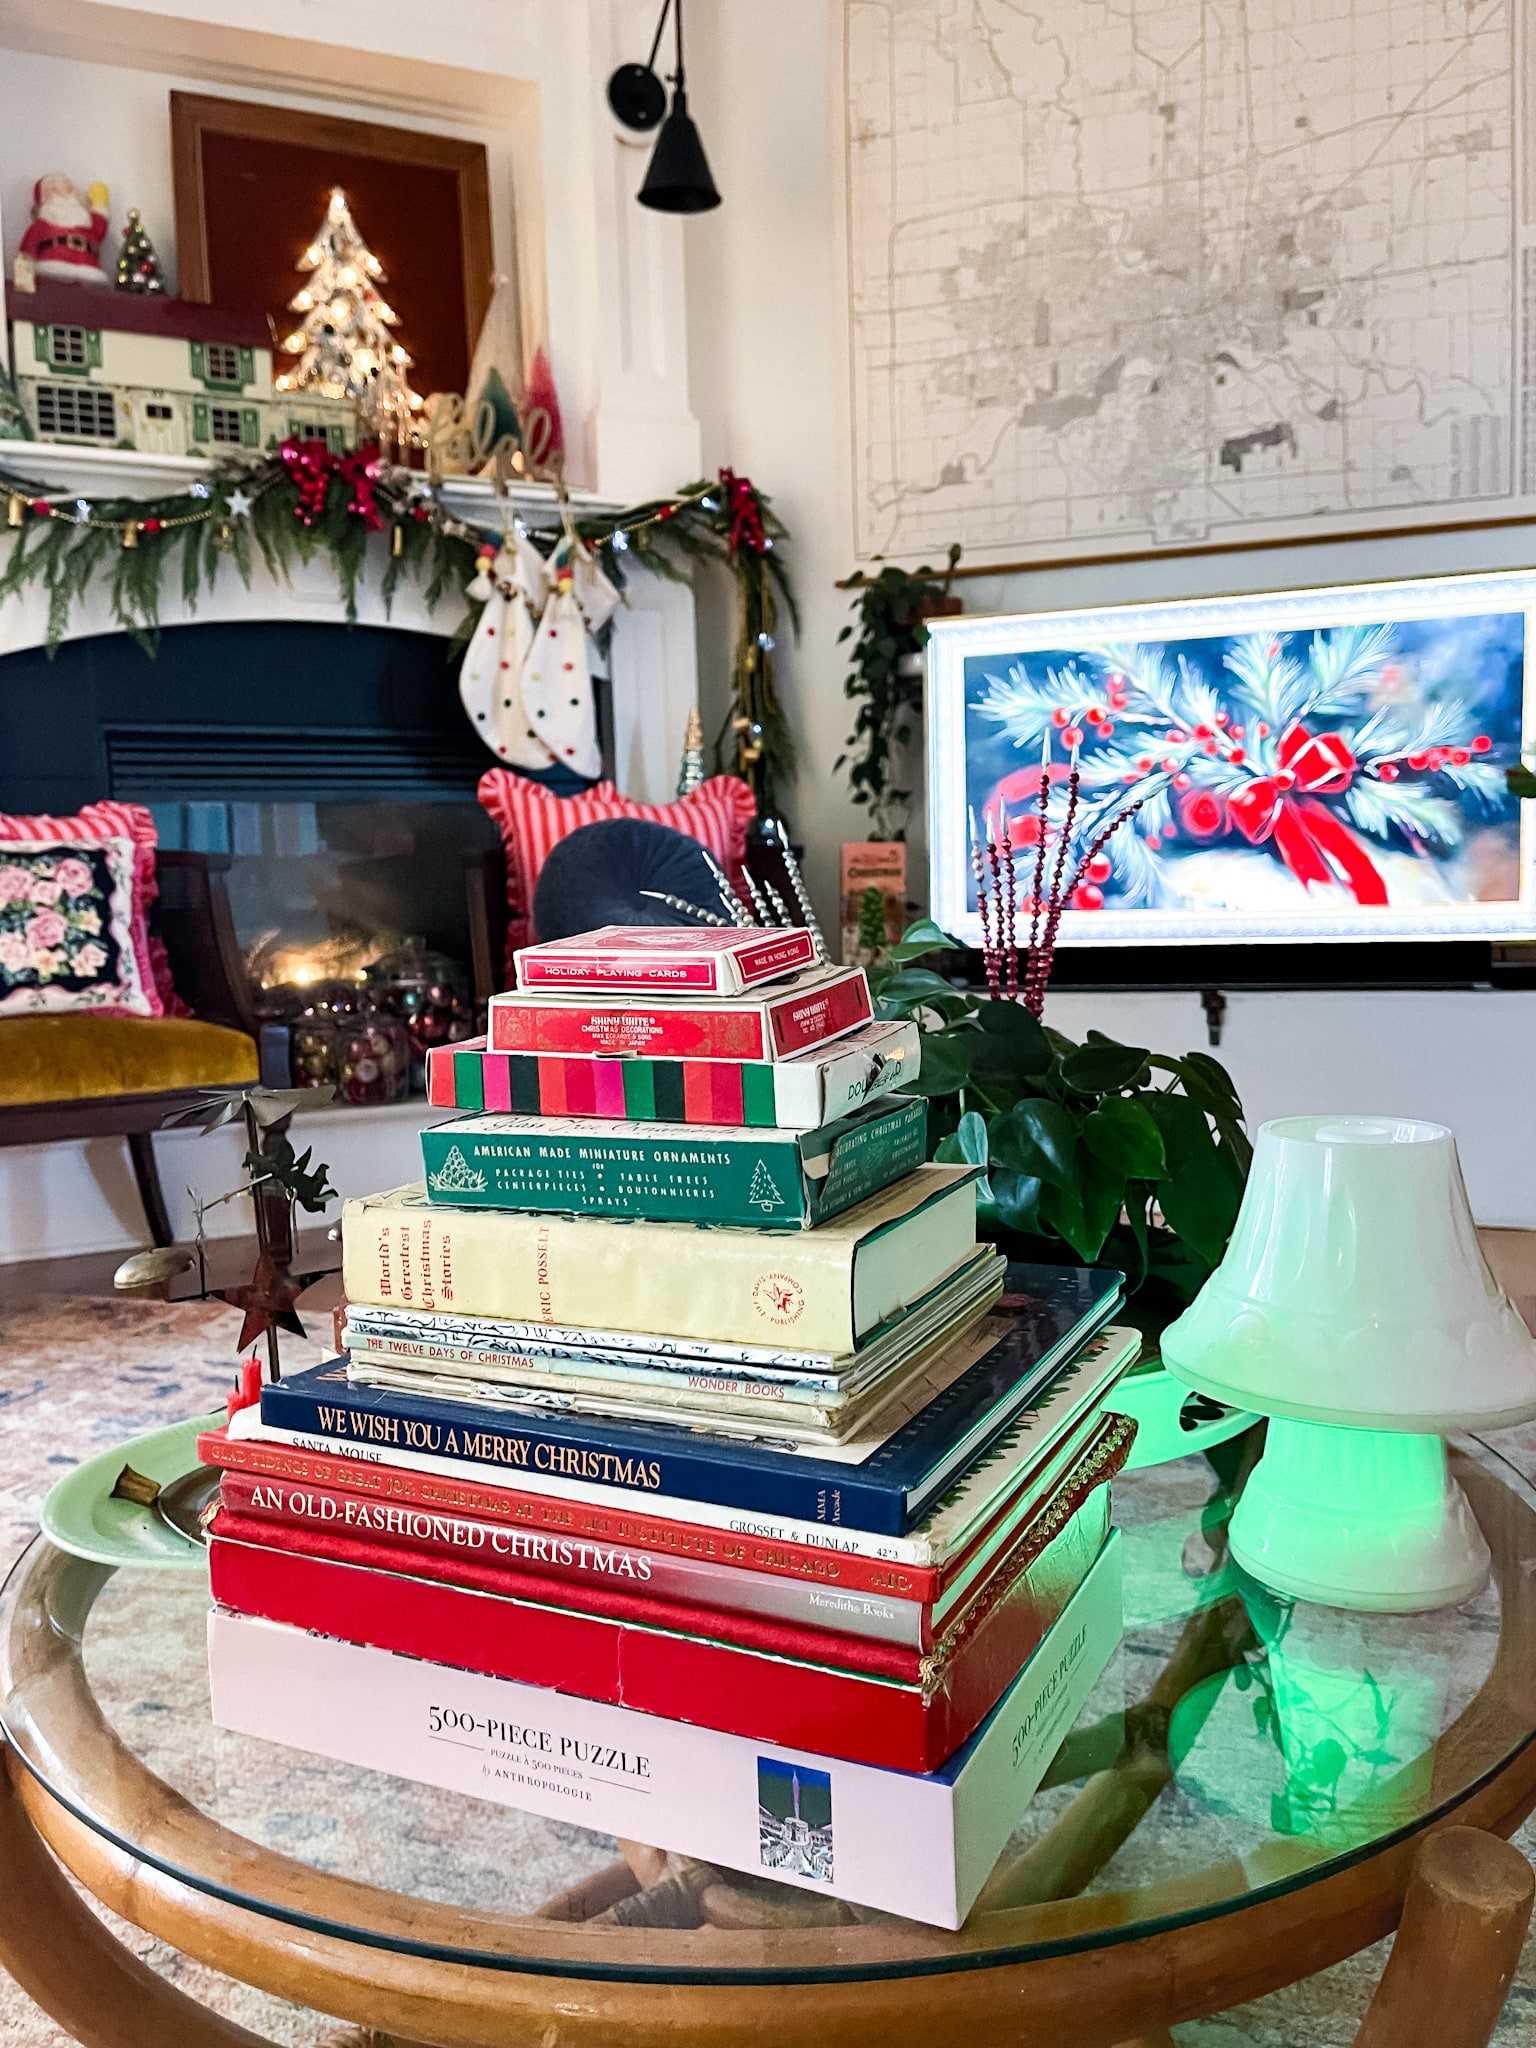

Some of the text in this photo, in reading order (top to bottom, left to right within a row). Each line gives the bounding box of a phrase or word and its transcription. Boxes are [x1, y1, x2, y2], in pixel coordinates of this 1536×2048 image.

[545, 966, 687, 978] HOLIDAY PLAYING CARDS
[581, 1025, 663, 1034] CHRISTMAS DECORATIONS
[590, 1016, 620, 1025] SHINY
[474, 1145, 731, 1165] AMERICAN MADE MINIATURE ORNAMENTS
[495, 1168, 708, 1185] PACKAGE TIES TABLE TREES
[497, 1181, 715, 1199] CENTERPIECES BOUTONNIERES
[582, 1196, 628, 1206] SPRAYS
[378, 1227, 392, 1297] World's
[400, 1226, 413, 1300] Greatest
[420, 1220, 435, 1309] Christmas
[440, 1235, 453, 1301] Stories
[537, 1226, 554, 1324] ERIC POSSELT
[366, 1338, 534, 1368] THE TWELVE DAYS OF CHRISTMAS
[688, 1376, 785, 1399] WONDER BOOKS
[292, 1437, 382, 1463] SANTA MOUSE
[317, 1406, 661, 1489] WE WISH YOU A MERRY CHRISTMAS
[211, 1445, 246, 1463] GLAD
[251, 1452, 308, 1476] TIDINGS
[314, 1464, 331, 1479] OF
[337, 1468, 382, 1489] GREAT
[421, 1485, 511, 1514] CHRISTMAS
[515, 1503, 534, 1519] AT
[541, 1507, 574, 1526] THE
[581, 1517, 610, 1533] ART
[618, 1522, 716, 1555] INSTITUTE
[722, 1542, 746, 1560] OF
[752, 1548, 840, 1578] CHICAGO
[250, 1485, 652, 1581] AN OLD-FASHIONED CHRISTMAS
[730, 1520, 859, 1553] GROSSET & DUNLAP
[877, 1548, 899, 1560] 423
[863, 1603, 895, 1619] Books
[429, 1705, 651, 1778] 500-PIECE PUZZLE
[490, 1748, 521, 1763] PUZZLE
[524, 1752, 530, 1766] À
[532, 1759, 551, 1771] 500
[495, 1769, 592, 1802] ANTHROPOLOGIE
